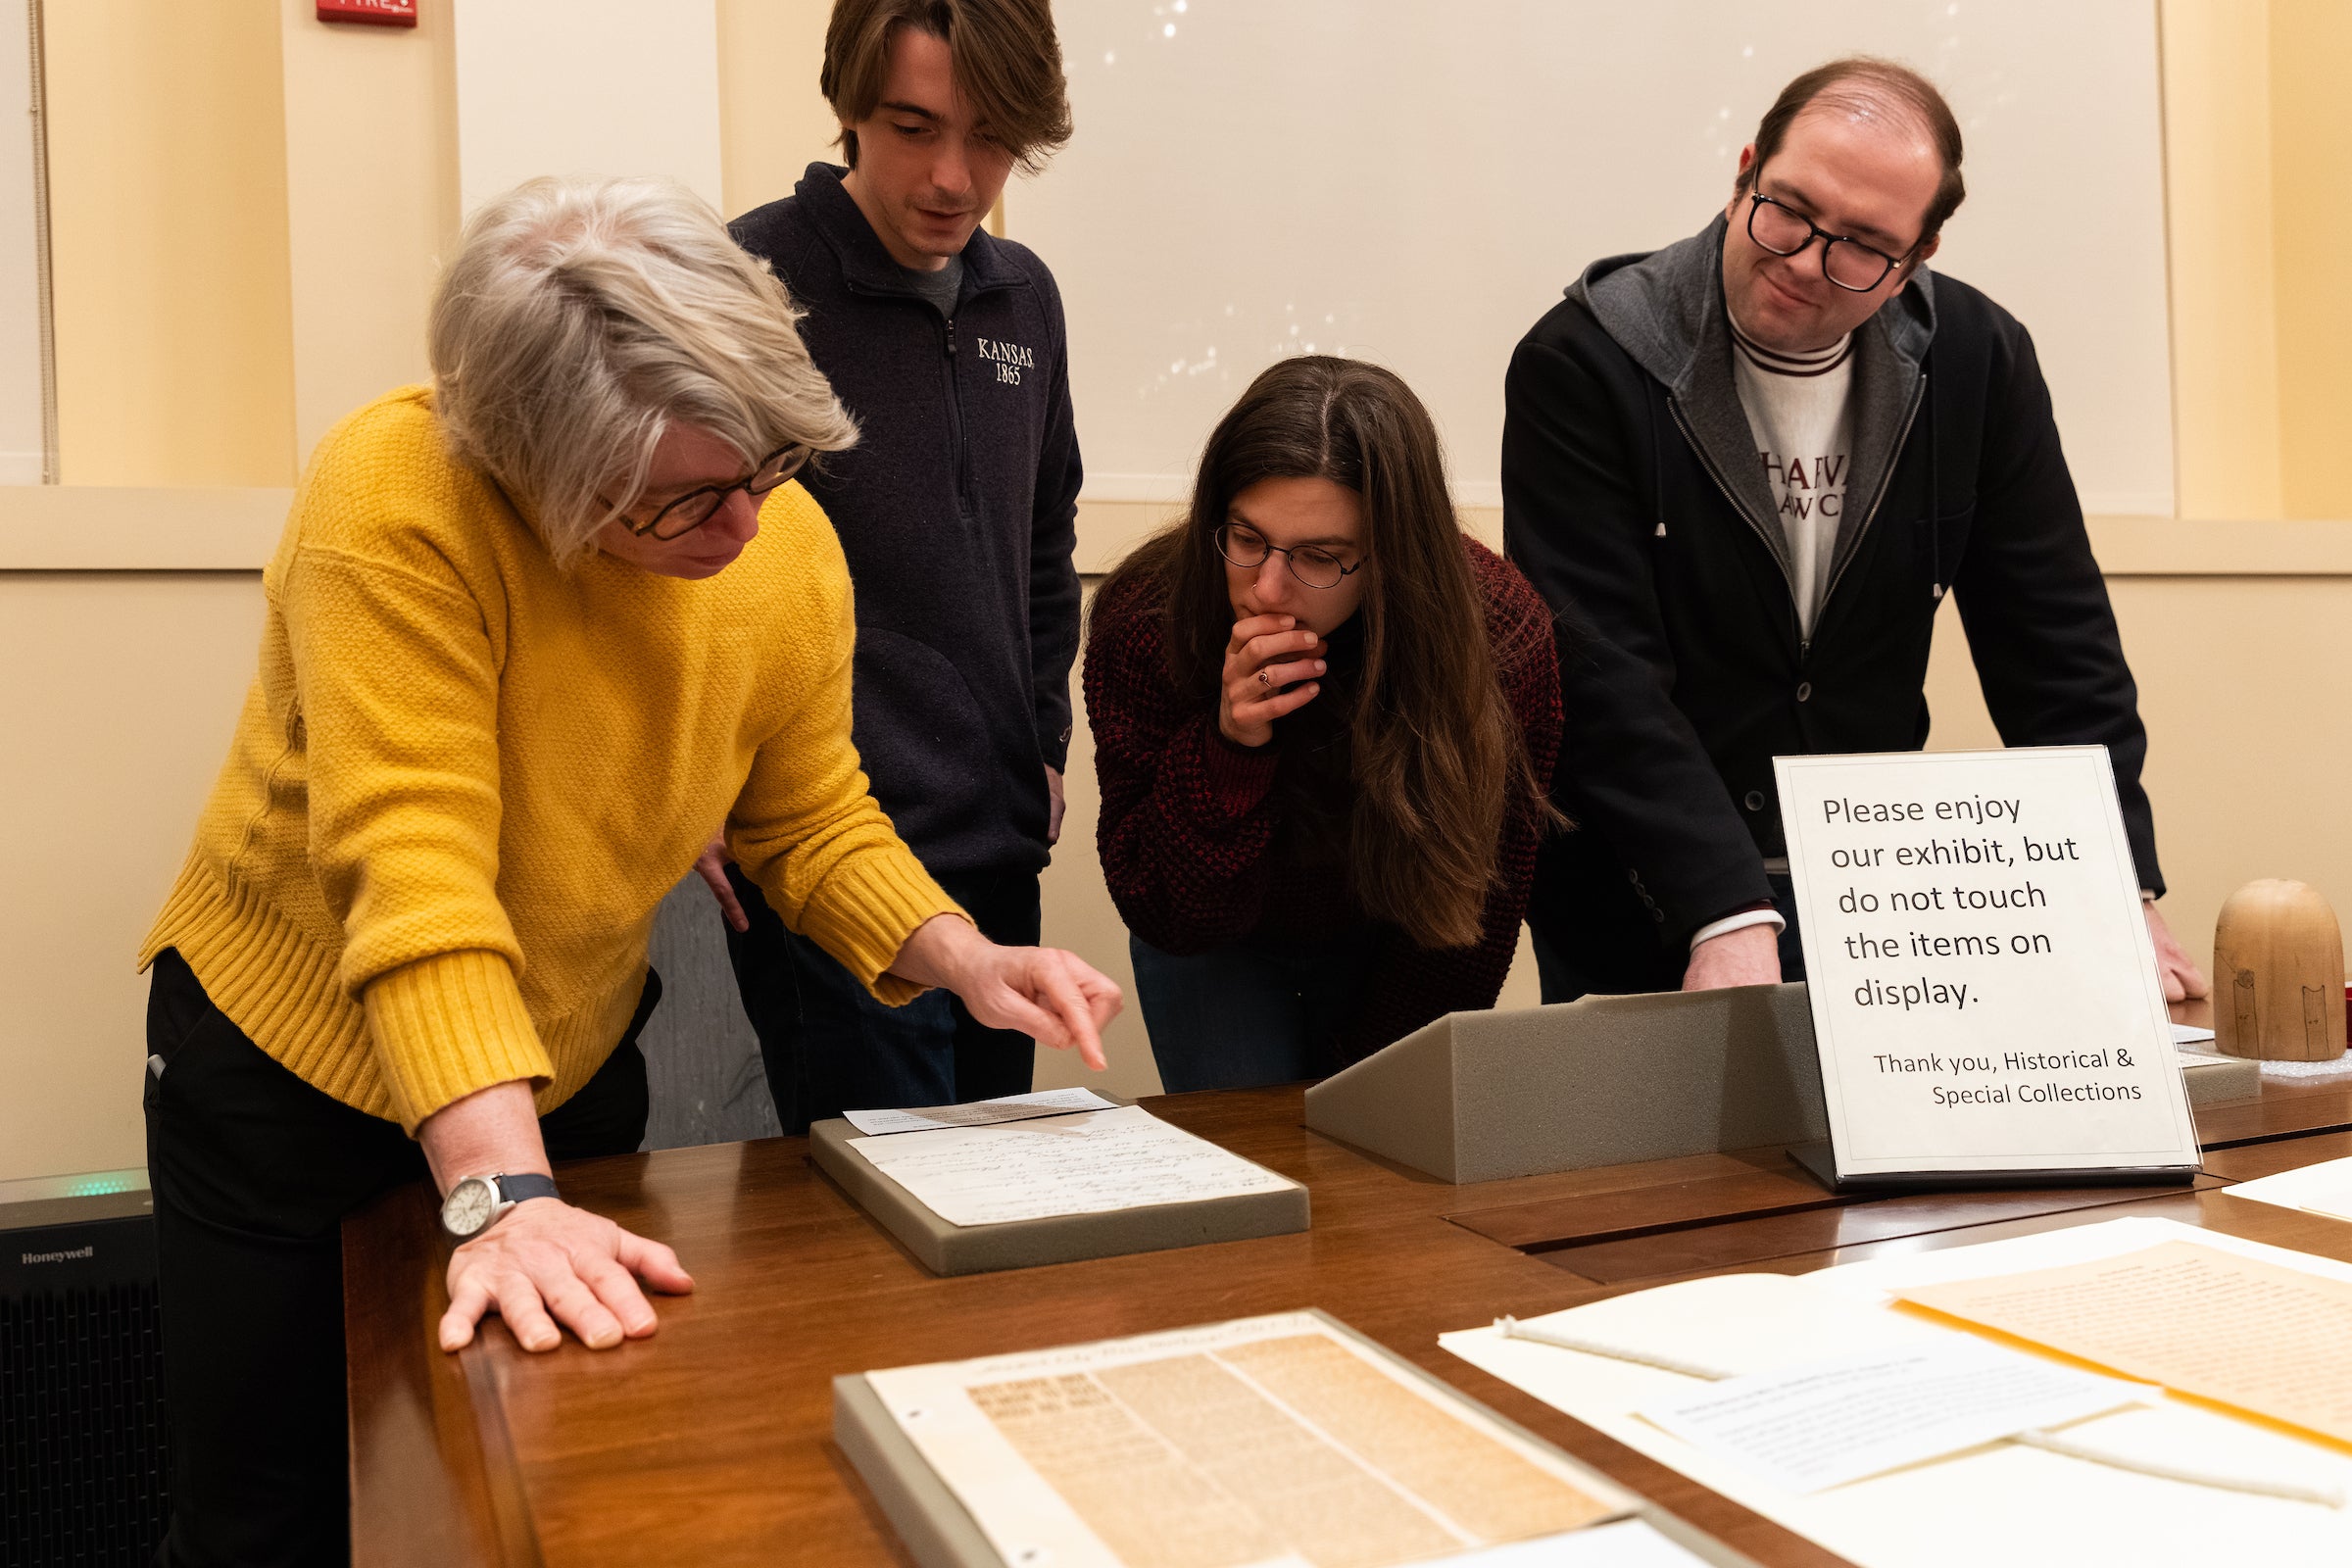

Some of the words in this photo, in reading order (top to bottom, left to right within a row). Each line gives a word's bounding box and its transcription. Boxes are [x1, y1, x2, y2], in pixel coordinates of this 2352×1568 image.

[977, 338, 1033, 368] KANSAS
[996, 363, 1021, 385] 1865
[1823, 798, 1925, 824] Please
[1935, 795, 2021, 824] enjoy
[1831, 849, 1885, 868] our
[1895, 838, 2014, 868] exhibit,
[2023, 836, 2080, 862] but
[1838, 887, 1880, 913] do
[1889, 888, 1945, 911] not
[1952, 881, 2047, 909] touch
[1844, 933, 1900, 959] the
[1910, 932, 2000, 957] items
[2010, 935, 2052, 955] on
[1854, 977, 1979, 1010] display.
[1873, 1053, 1944, 1074] Thank
[1948, 1057, 1997, 1076] you,
[2003, 1049, 2109, 1071] Historical
[2116, 1048, 2135, 1067] &
[1933, 1084, 2011, 1109] Special
[2018, 1083, 2142, 1103] Collections
[22, 1246, 94, 1265] Honeywell
